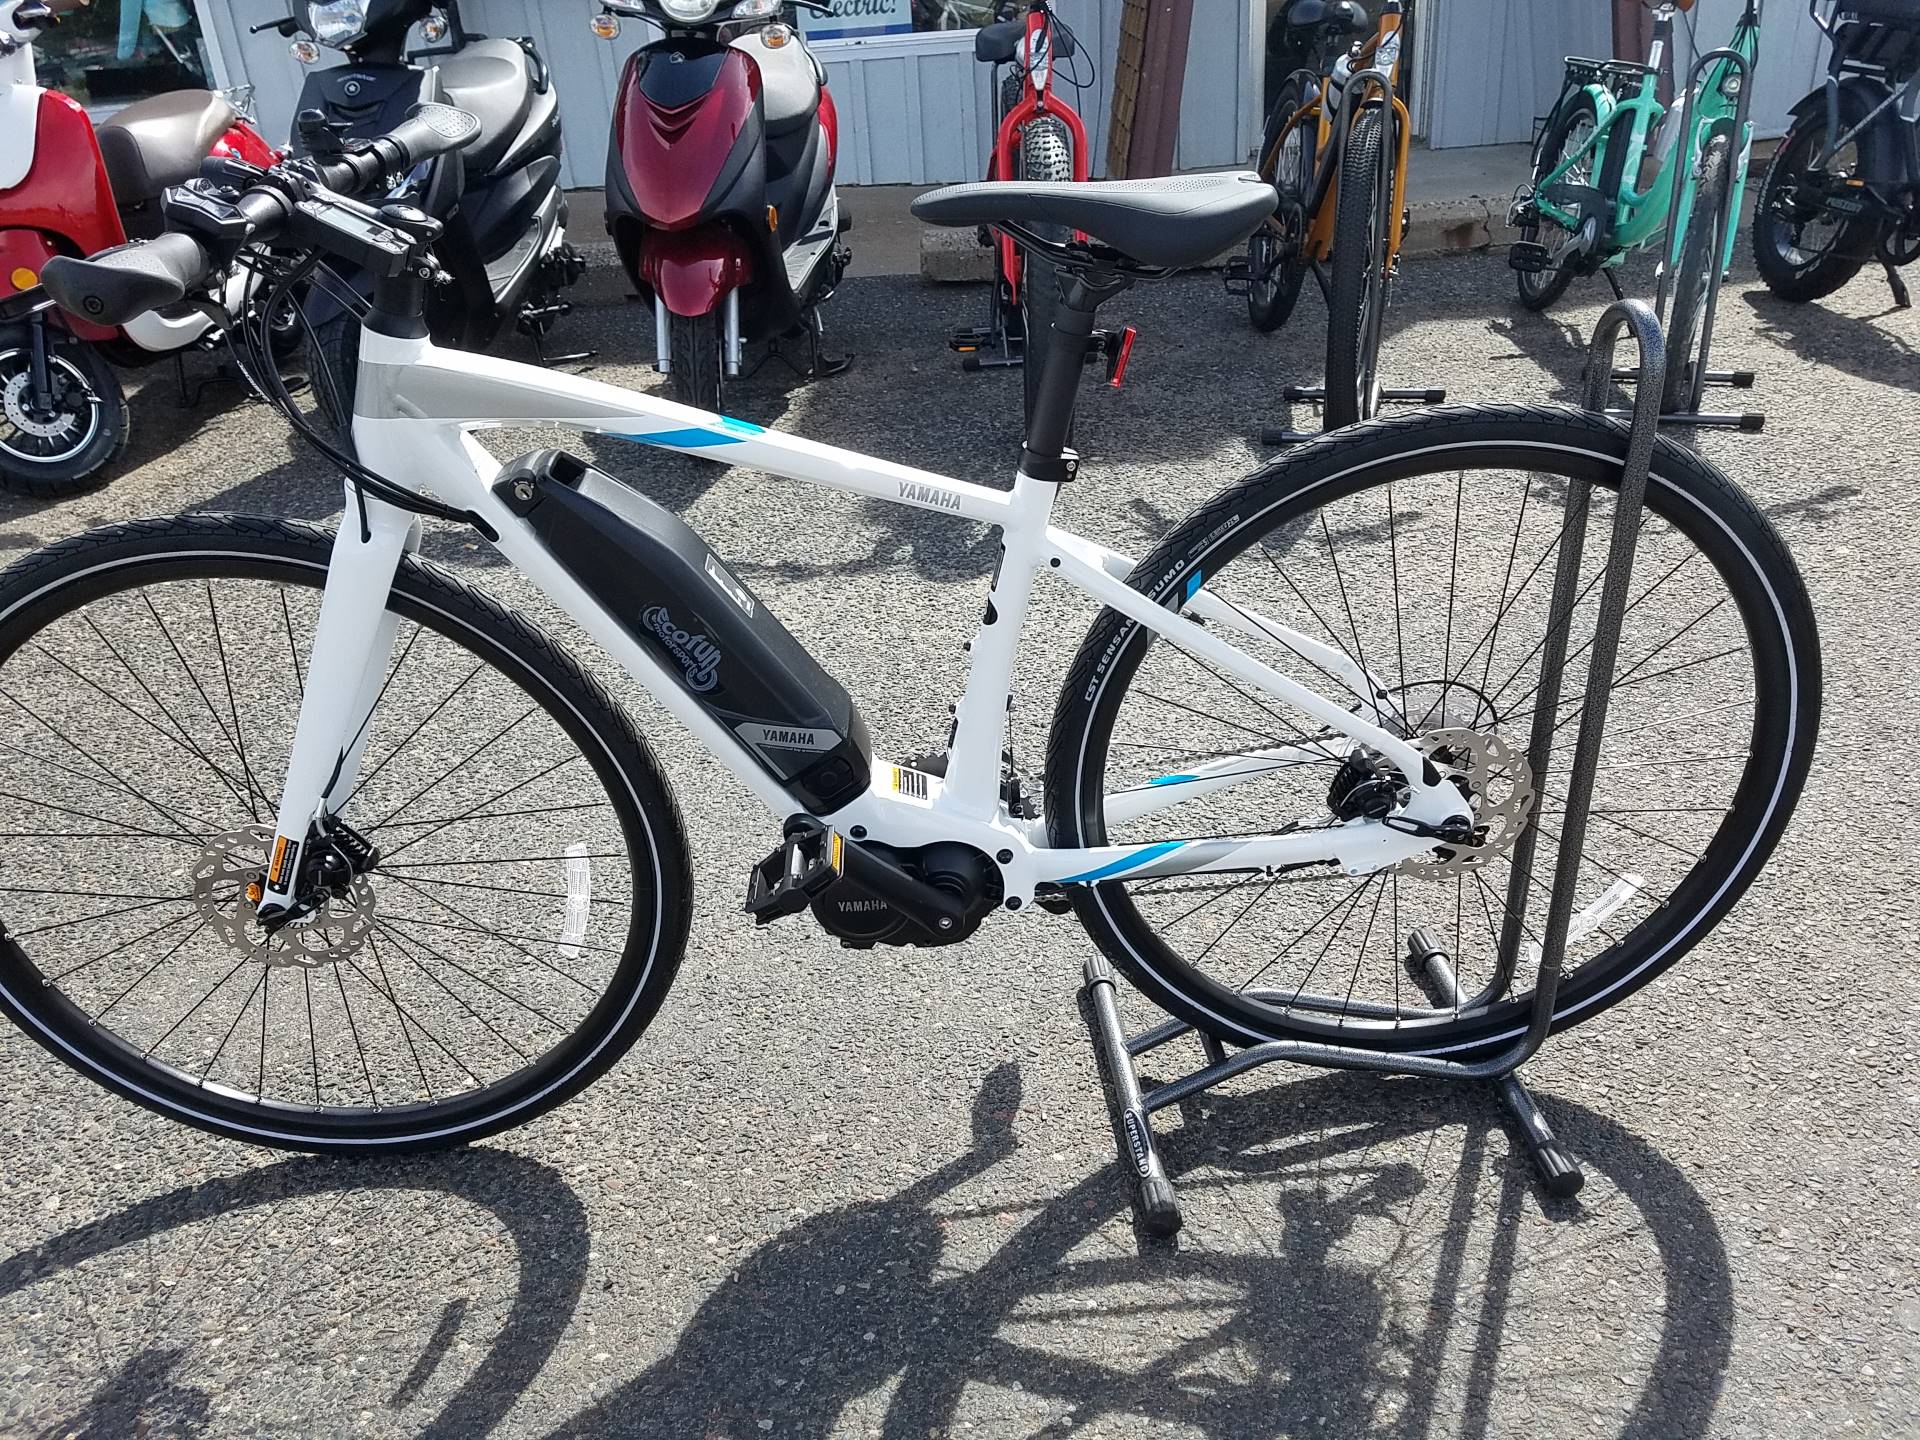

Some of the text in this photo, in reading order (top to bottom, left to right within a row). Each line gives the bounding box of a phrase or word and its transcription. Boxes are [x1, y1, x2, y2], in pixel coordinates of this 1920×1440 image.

[899, 481, 961, 511] YAMAHA
[1085, 675, 1100, 702] CST
[1147, 559, 1185, 600] SUMO
[763, 728, 815, 745] YAMAHA
[837, 899, 888, 912] YAMAHA
[1125, 1112, 1150, 1173] SUPERSTAND
